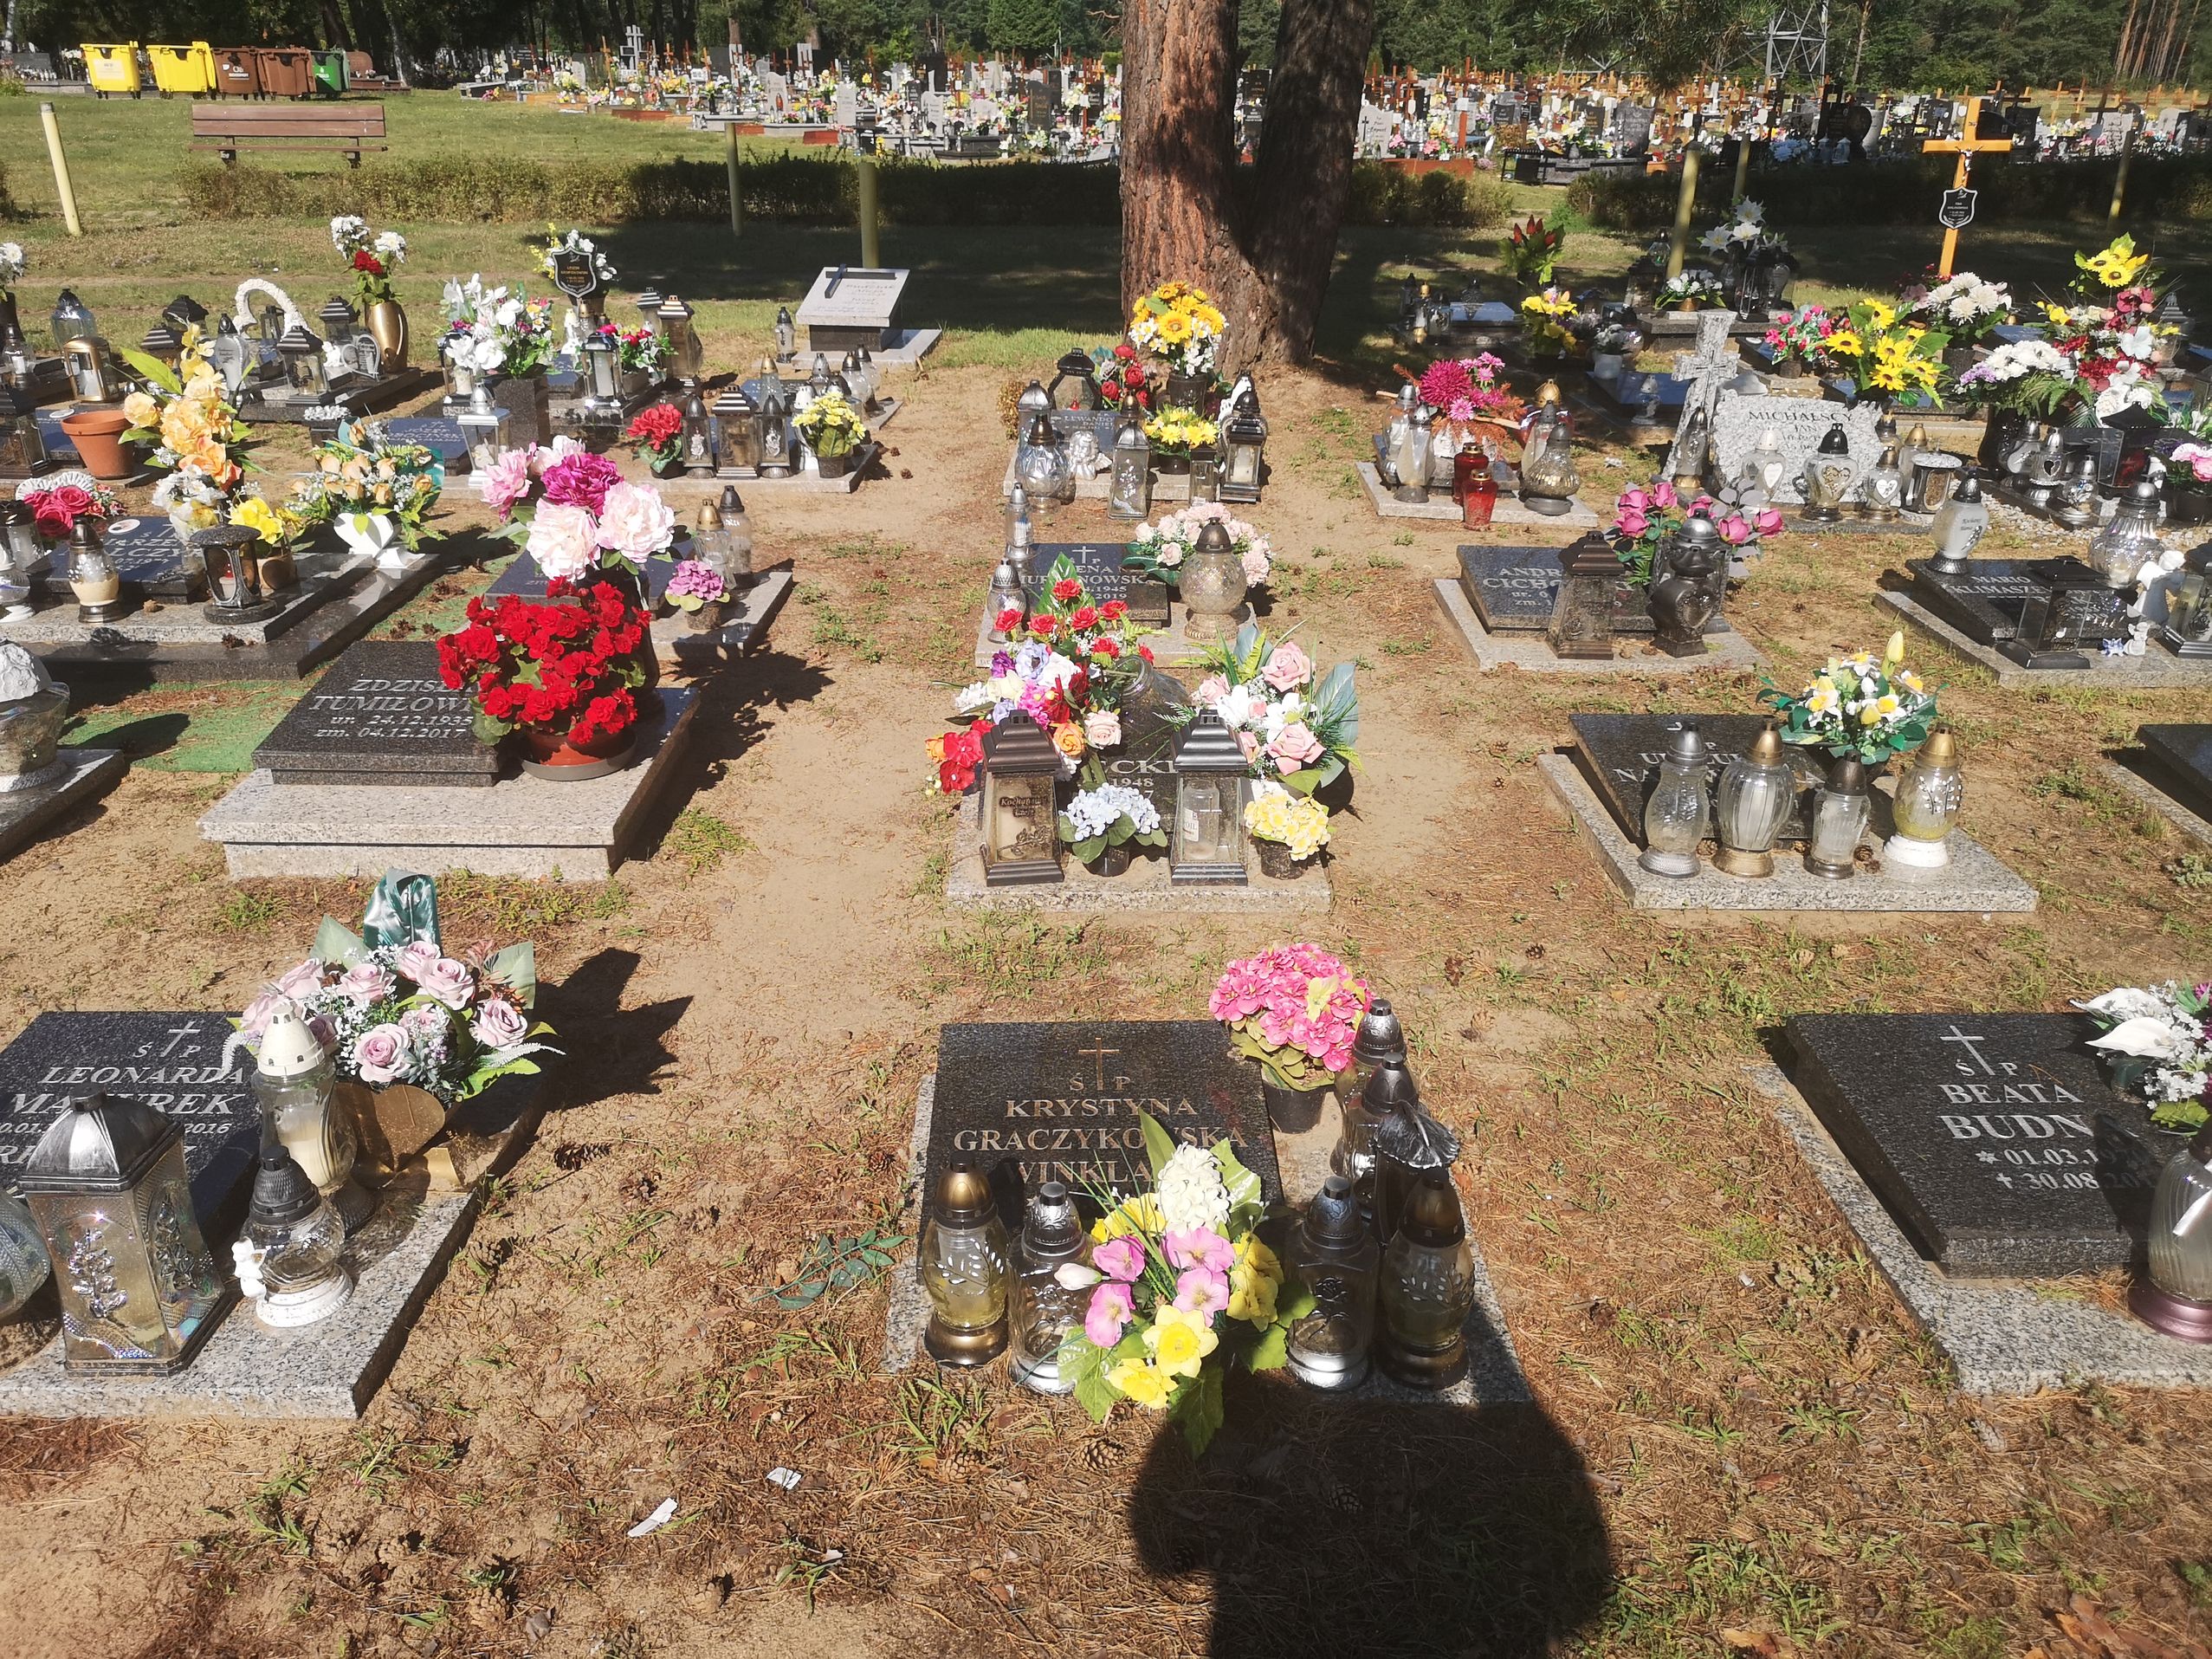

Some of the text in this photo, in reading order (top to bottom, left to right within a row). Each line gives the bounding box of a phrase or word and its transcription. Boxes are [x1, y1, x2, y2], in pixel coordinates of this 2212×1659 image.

[1498, 567, 1562, 577] ANDR
[1970, 575, 2031, 584] MARIO
[366, 715, 475, 727] 24.12.1935
[358, 727, 469, 739] 04.12.2017
[179, 1045, 202, 1058] P
[40, 1066, 246, 1084] LEONARDA
[1998, 1062, 2018, 1076] P
[1116, 1076, 1131, 1091] P
[1937, 1083, 2085, 1104] BEATA
[12, 1093, 246, 1115] MAREK
[1004, 1098, 1199, 1118] KRYSTYNA
[1937, 1114, 2139, 1139] BUDN
[954, 1126, 1250, 1151] GRACZYKOSKA
